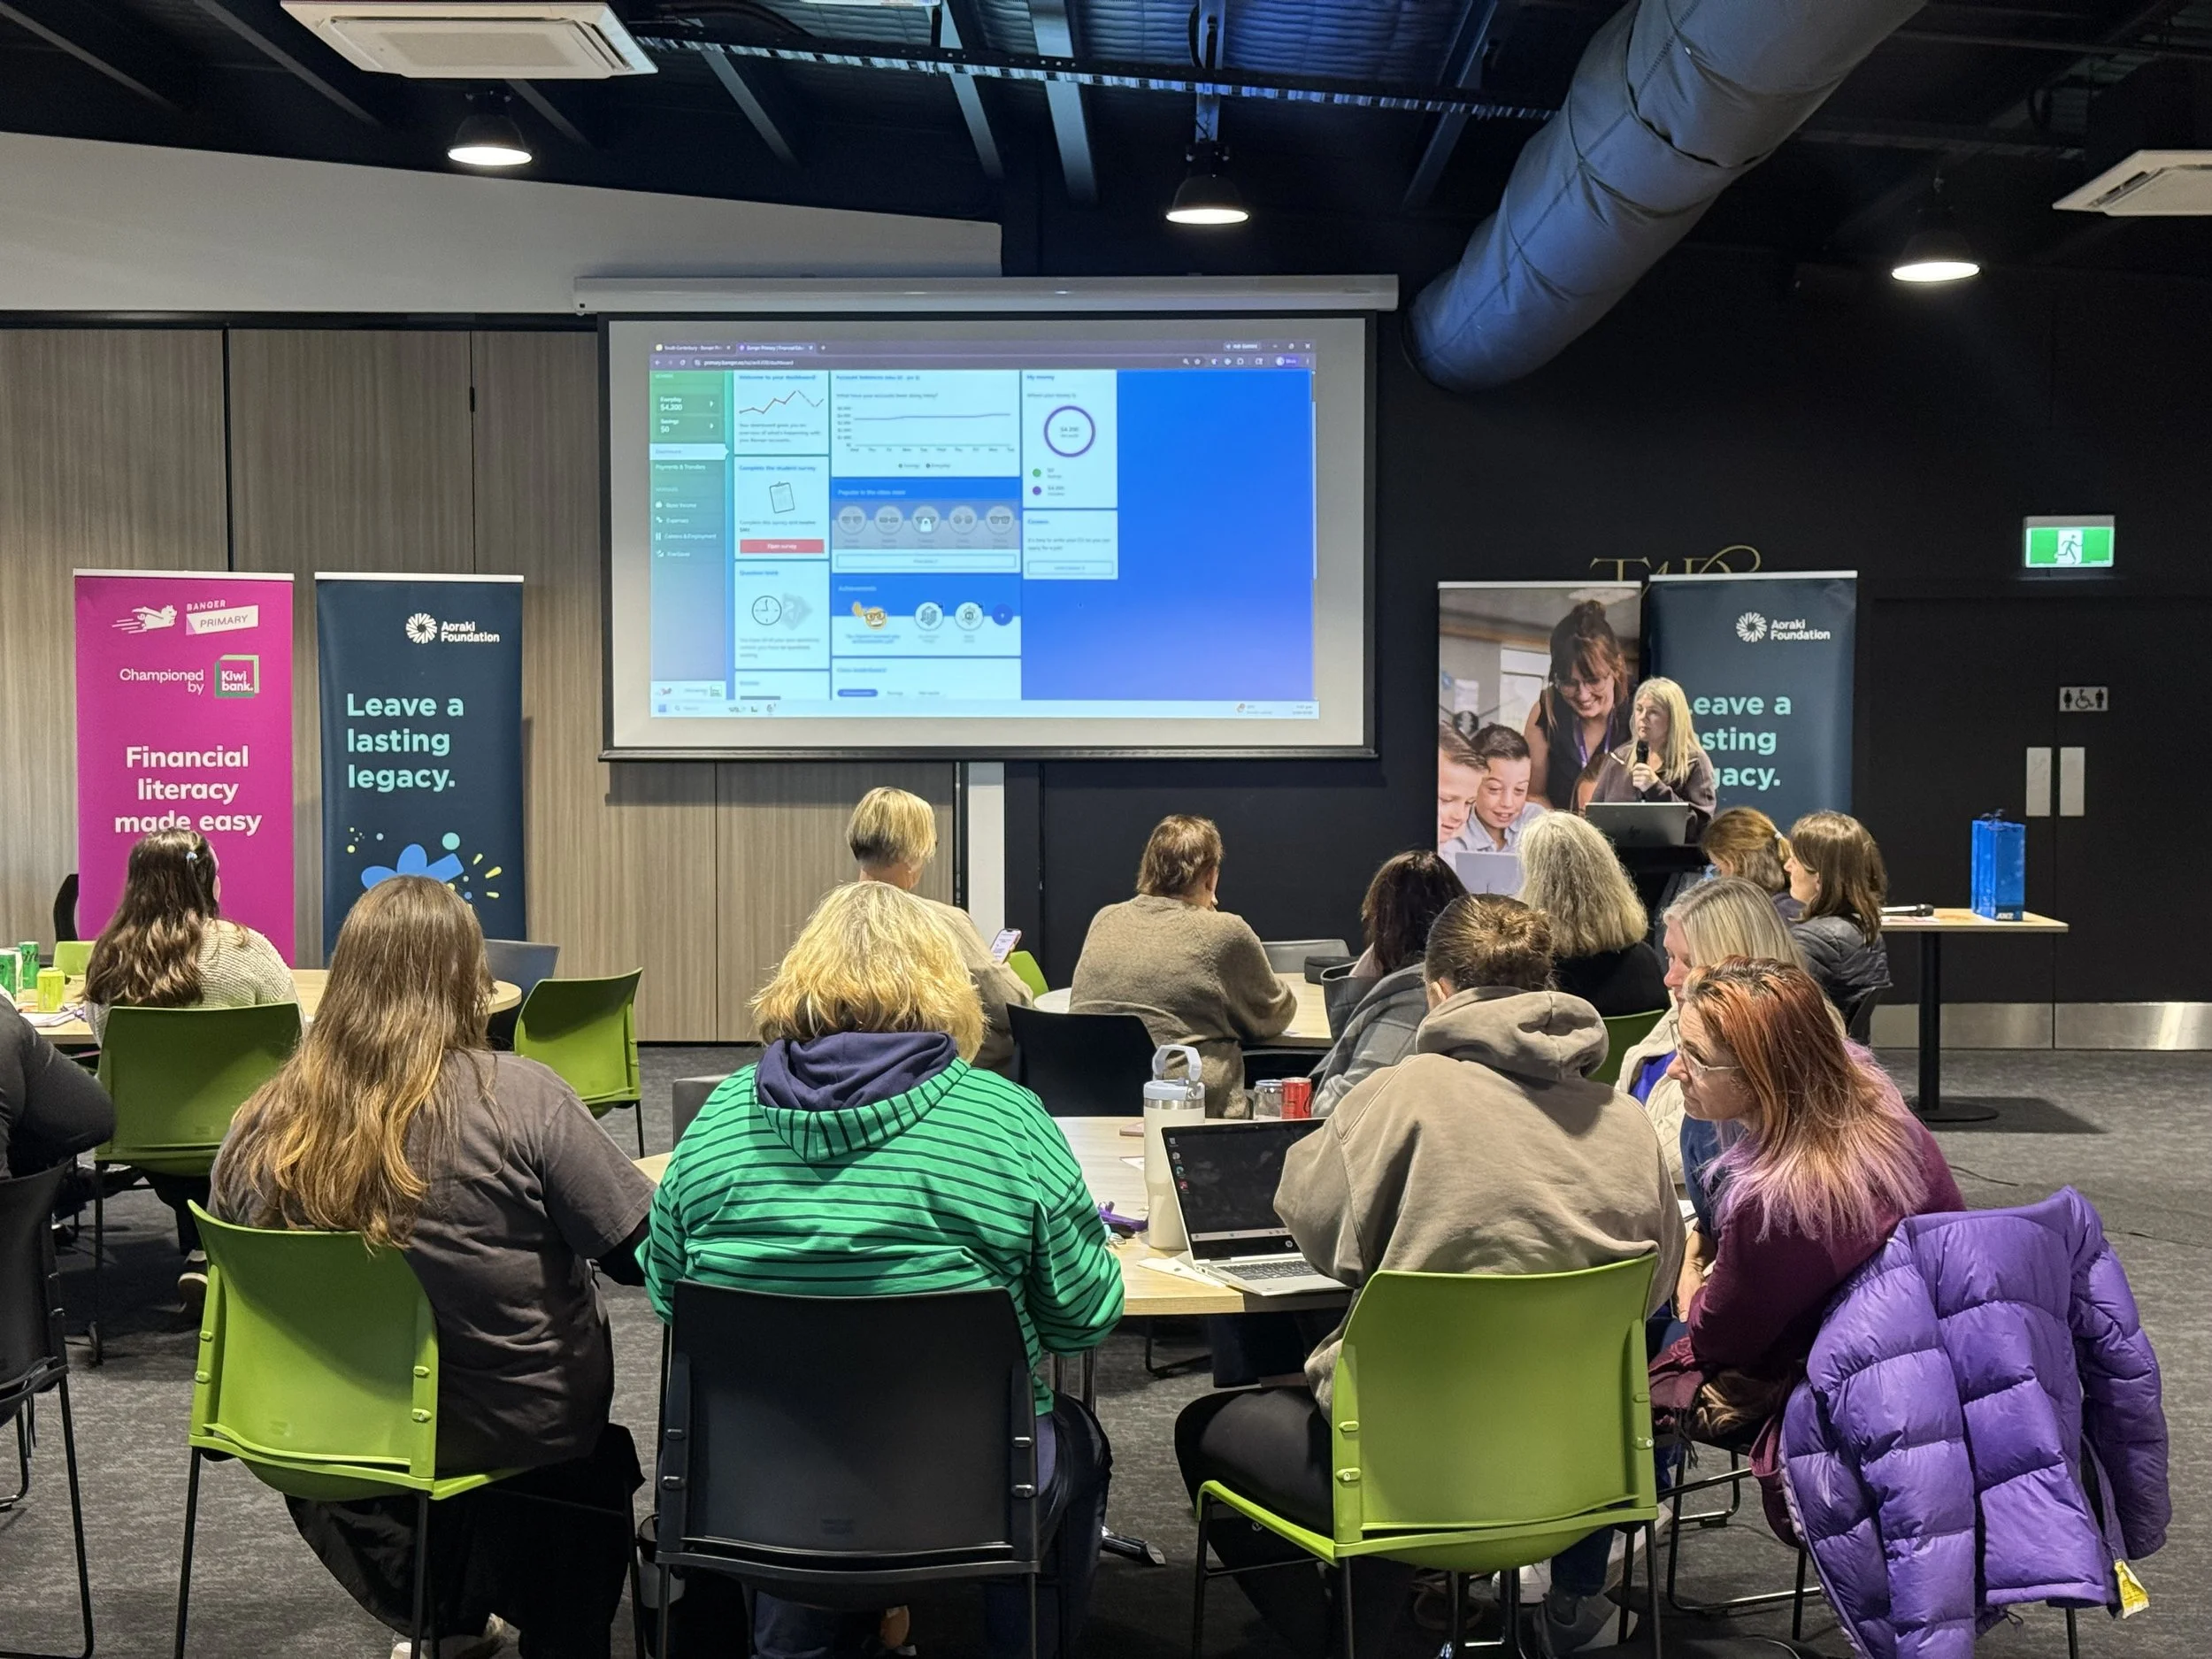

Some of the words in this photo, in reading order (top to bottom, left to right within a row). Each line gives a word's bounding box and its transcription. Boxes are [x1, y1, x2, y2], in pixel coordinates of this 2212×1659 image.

[200, 614, 249, 628] PRIMARY
[442, 621, 475, 632] Aoraki
[1771, 619, 1806, 629] Aoraki
[441, 632, 500, 642] Foundation
[1770, 629, 1831, 641] Foundation
[119, 668, 204, 683] Championed
[221, 671, 247, 681] Kiwi
[188, 681, 204, 695] by
[347, 693, 437, 718] Leave
[447, 696, 465, 718] a
[1689, 696, 1764, 715] eave
[1774, 696, 1792, 715] a
[347, 728, 450, 756] lasting
[1696, 726, 1777, 755] sting
[126, 745, 249, 768] Financial
[348, 764, 456, 793] legacy.
[137, 778, 239, 803] literacy
[115, 810, 192, 833] made
[199, 815, 263, 836] easy
